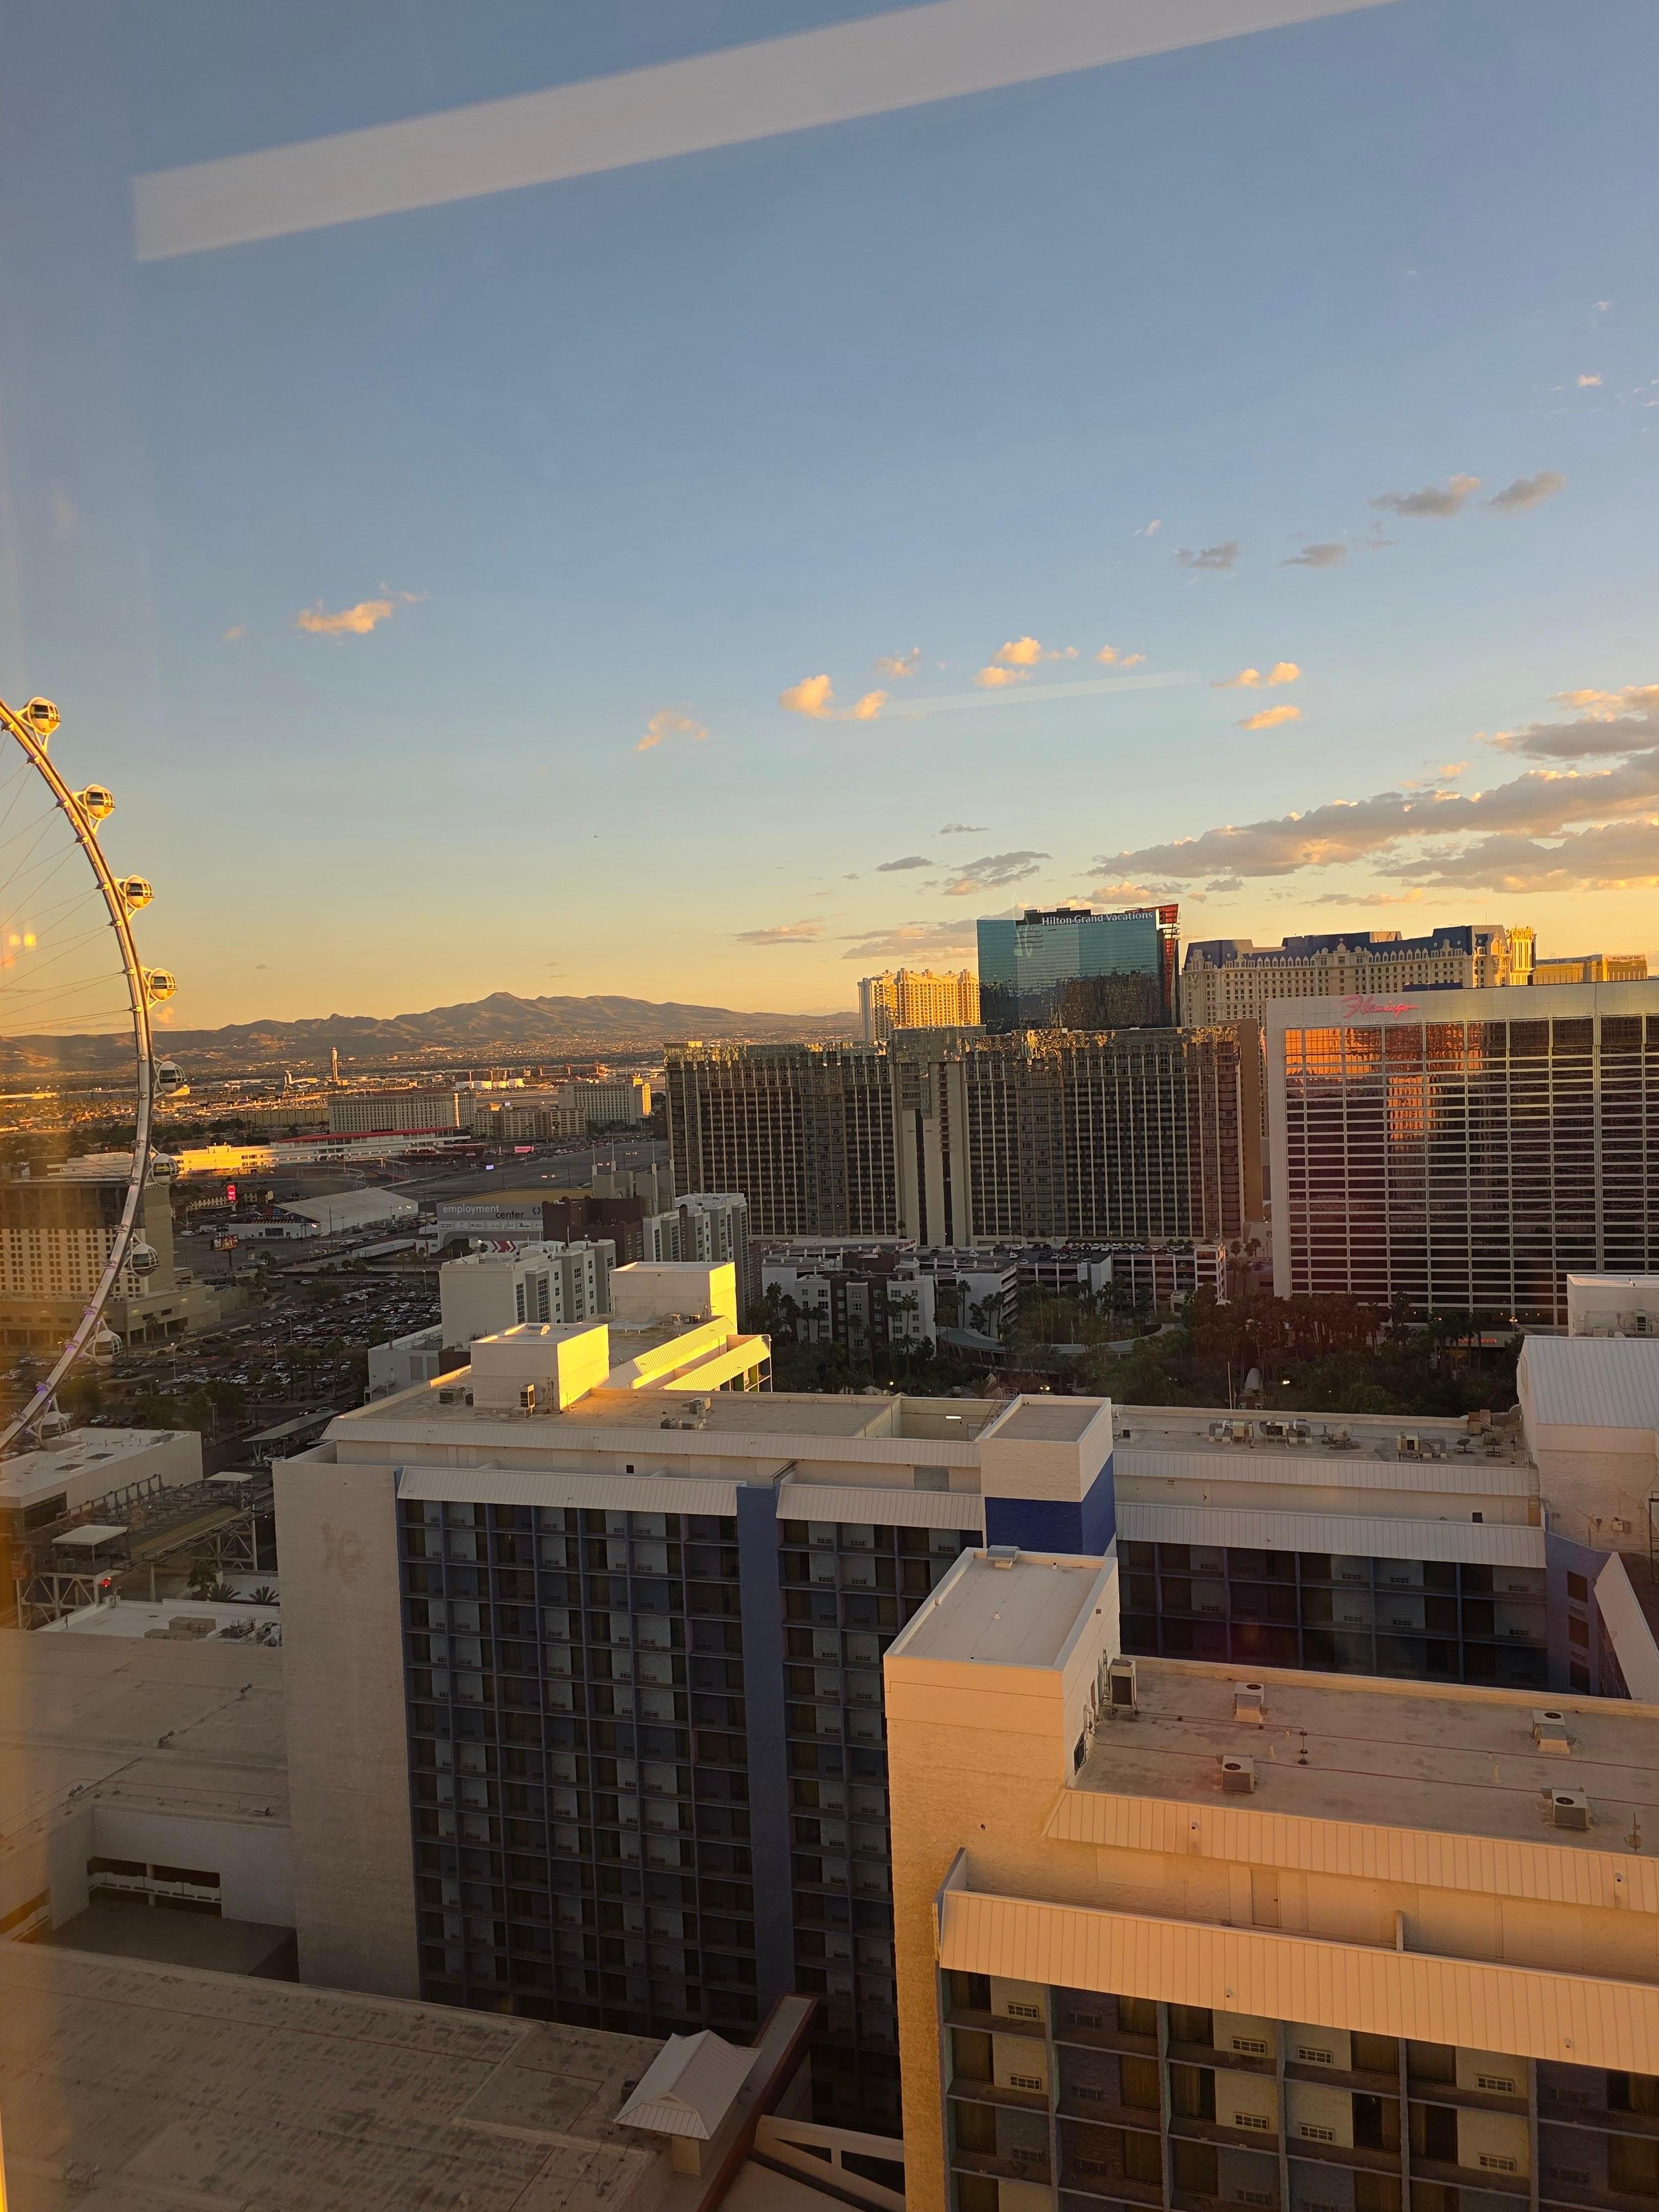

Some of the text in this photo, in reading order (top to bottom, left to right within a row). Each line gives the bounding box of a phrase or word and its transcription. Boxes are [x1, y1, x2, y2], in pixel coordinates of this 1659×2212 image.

[1042, 911, 1153, 926] Hilton Grand Vacations
[1342, 994, 1420, 1018] Flamingo
[443, 1203, 499, 1215] employment
[495, 1211, 524, 1219] center
